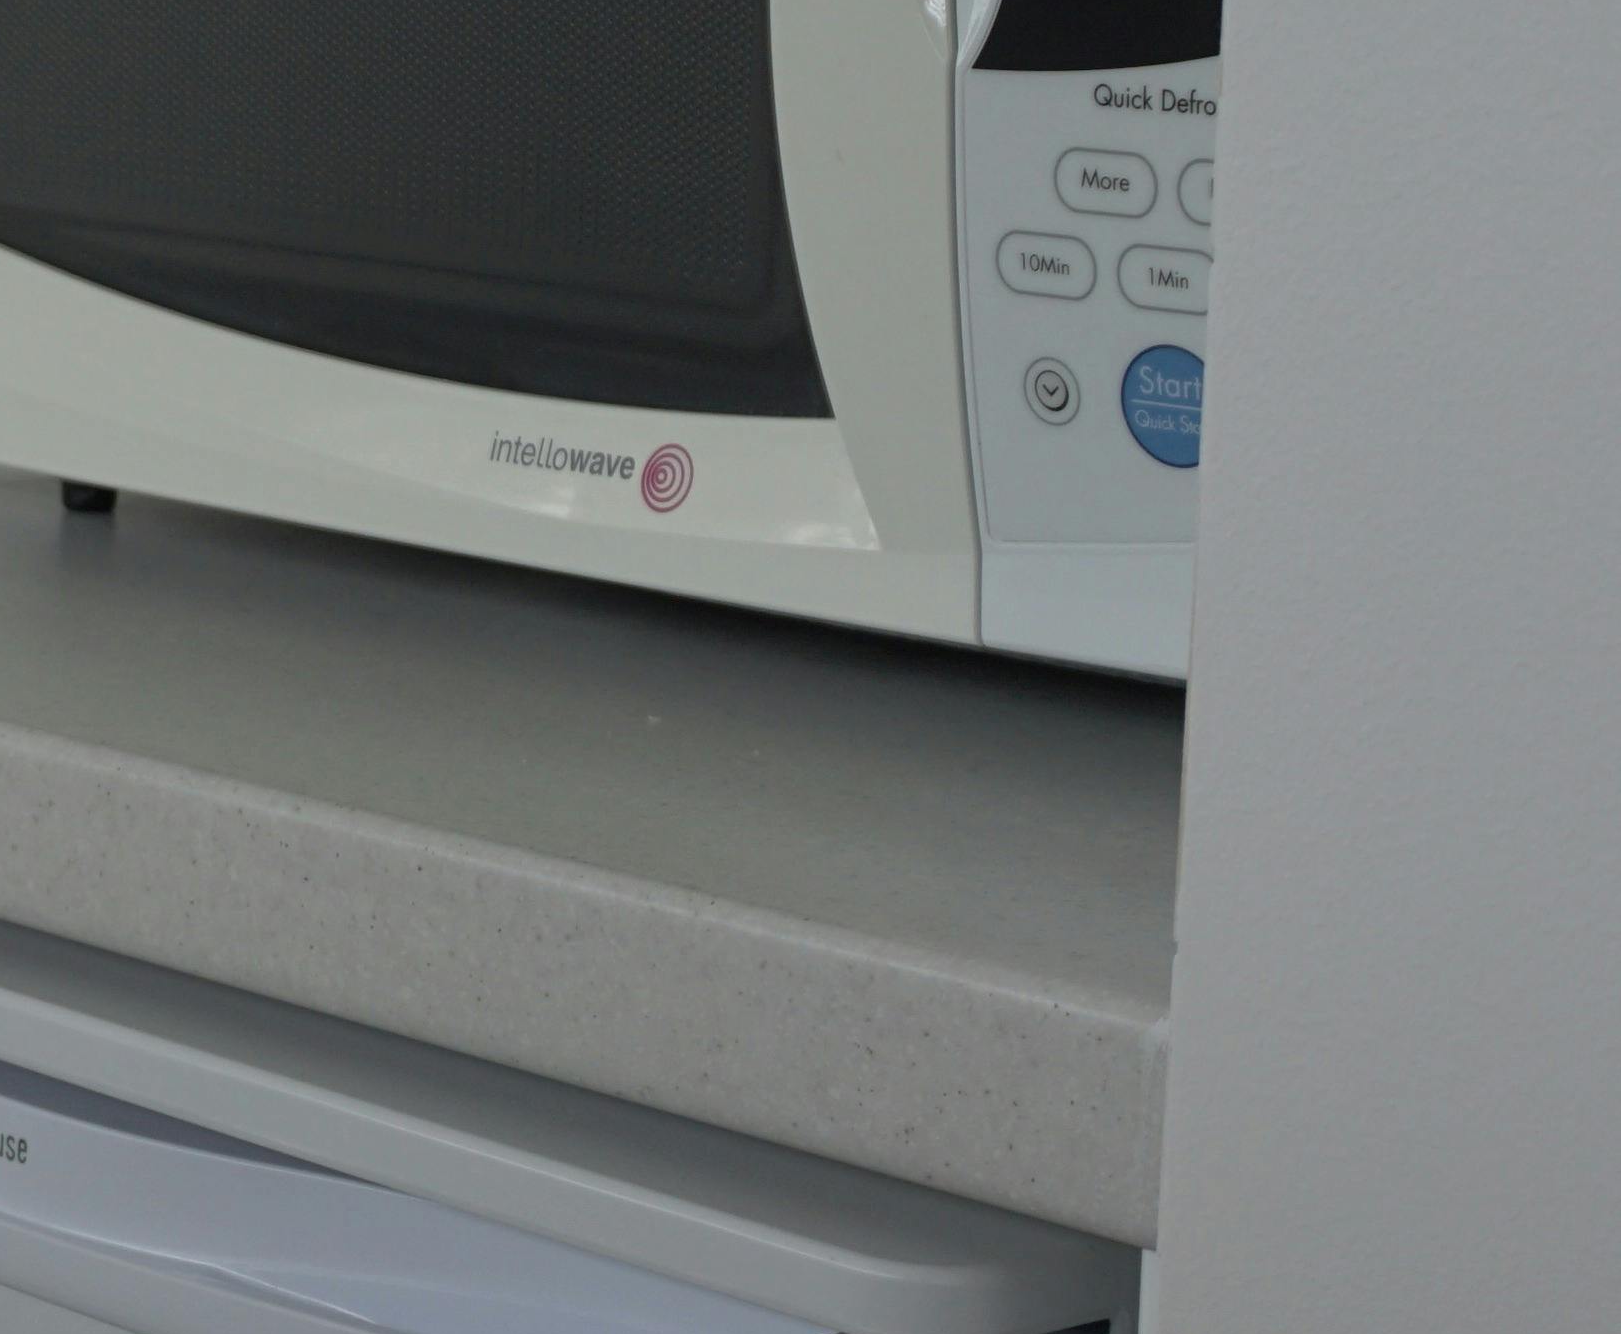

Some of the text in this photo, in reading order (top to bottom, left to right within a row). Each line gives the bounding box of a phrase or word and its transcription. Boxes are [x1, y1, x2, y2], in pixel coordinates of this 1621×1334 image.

[1094, 83, 1217, 116] Quick Defro
[1081, 167, 1130, 192] More
[1020, 252, 1071, 276] 10Min
[1148, 266, 1189, 290] 1Min
[1139, 364, 1202, 400] Start
[1134, 409, 1201, 435] Quick Sta
[489, 430, 635, 480] intellowave
